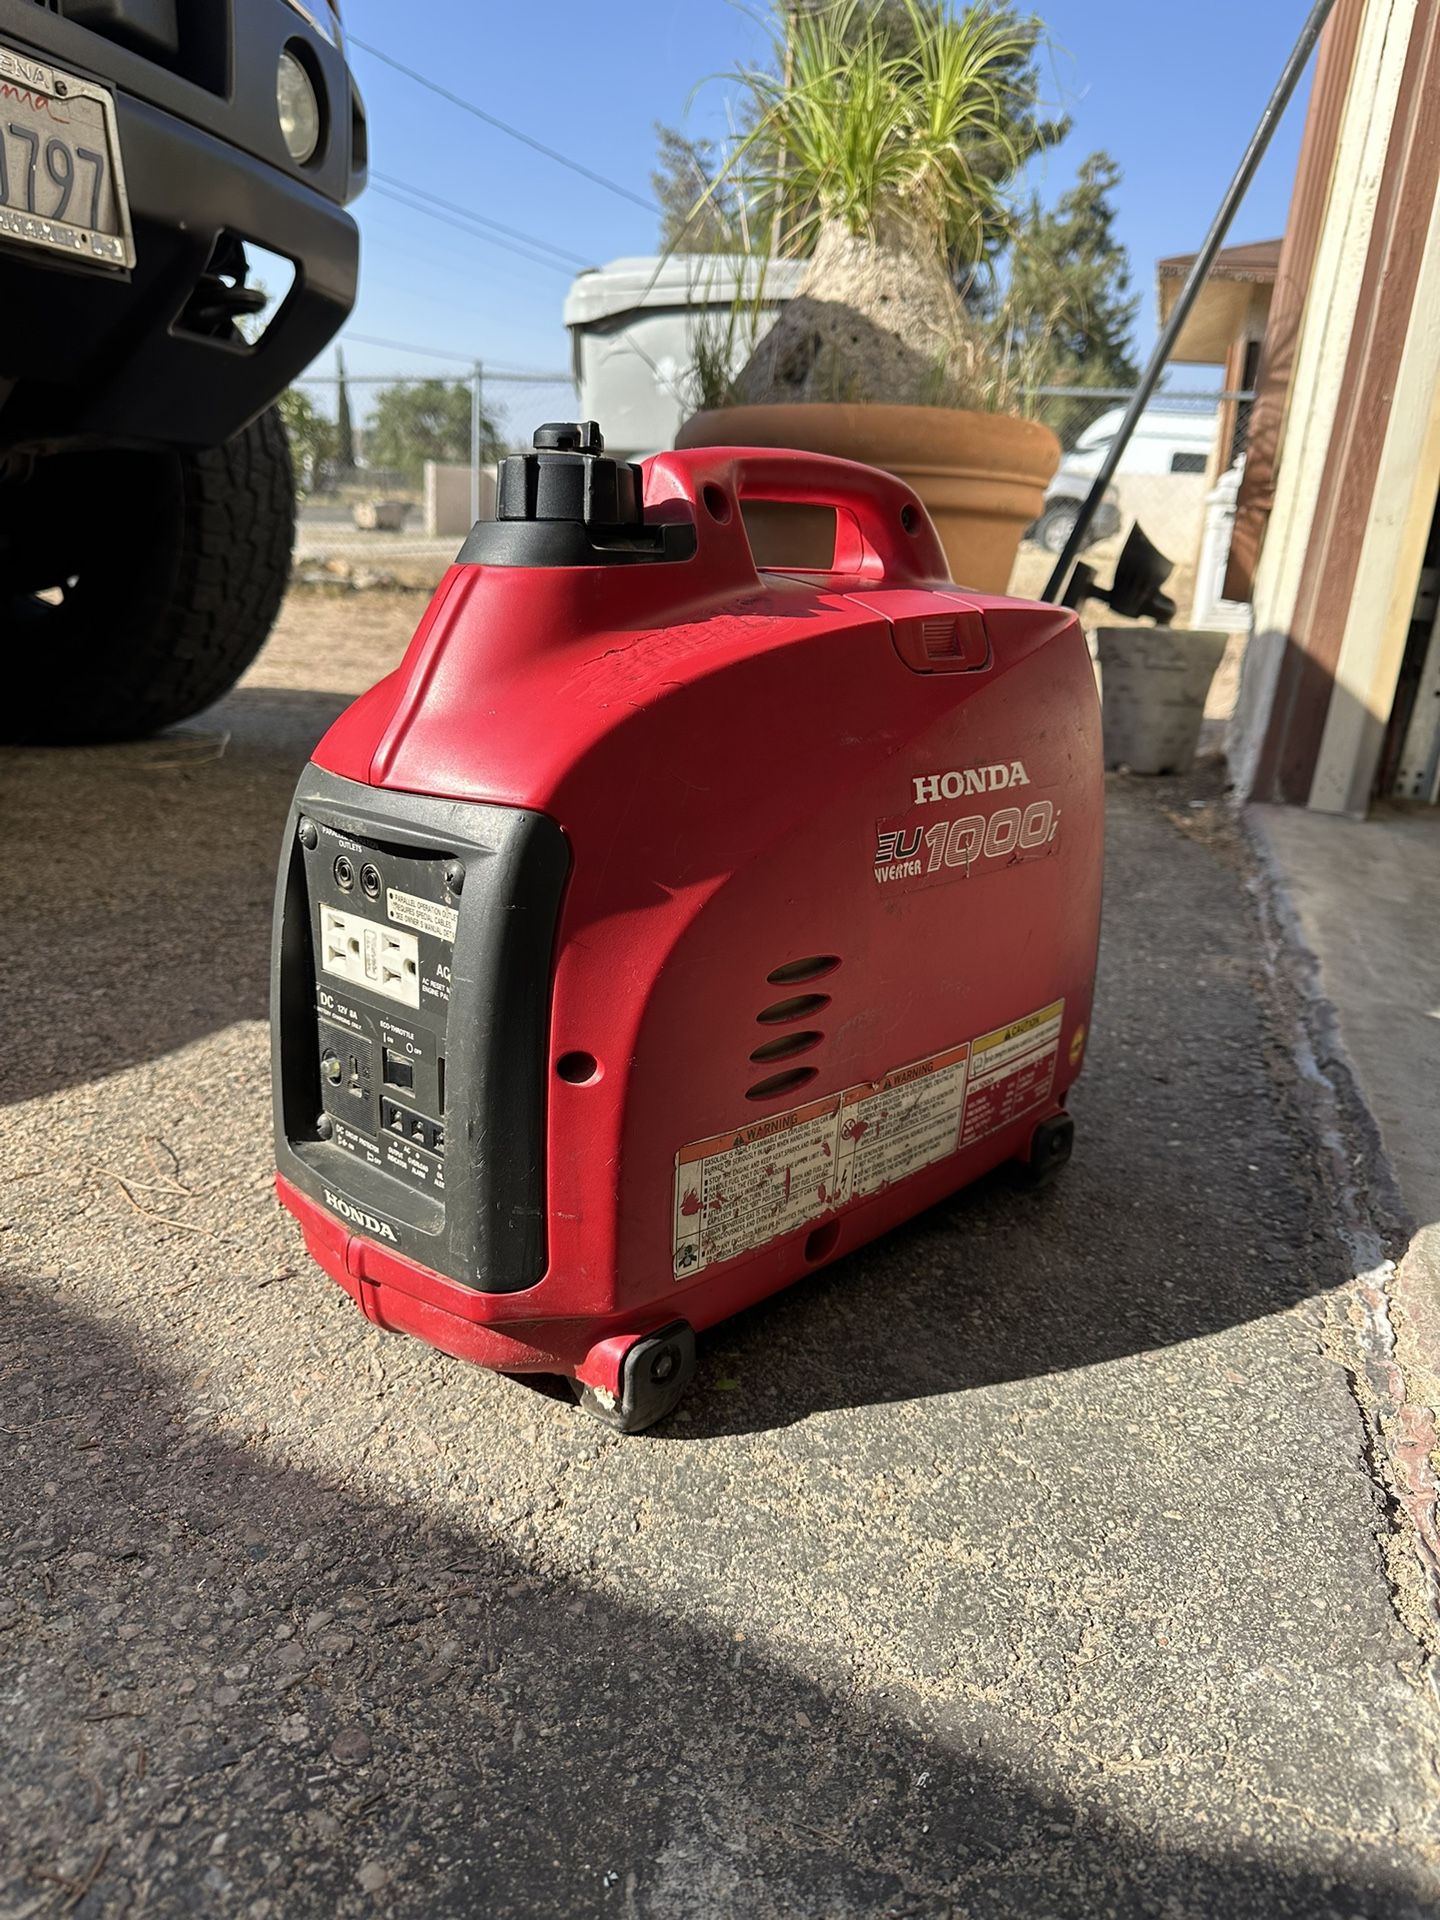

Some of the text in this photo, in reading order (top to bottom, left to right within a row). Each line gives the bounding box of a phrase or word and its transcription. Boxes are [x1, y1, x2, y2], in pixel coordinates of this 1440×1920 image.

[912, 760, 1031, 805] HONDA
[338, 839, 363, 854] OUTLETS
[320, 991, 333, 1009] DC
[893, 1061, 933, 1085] WARNING
[746, 1112, 798, 1141] WARNING
[323, 1188, 398, 1243] HONDA
